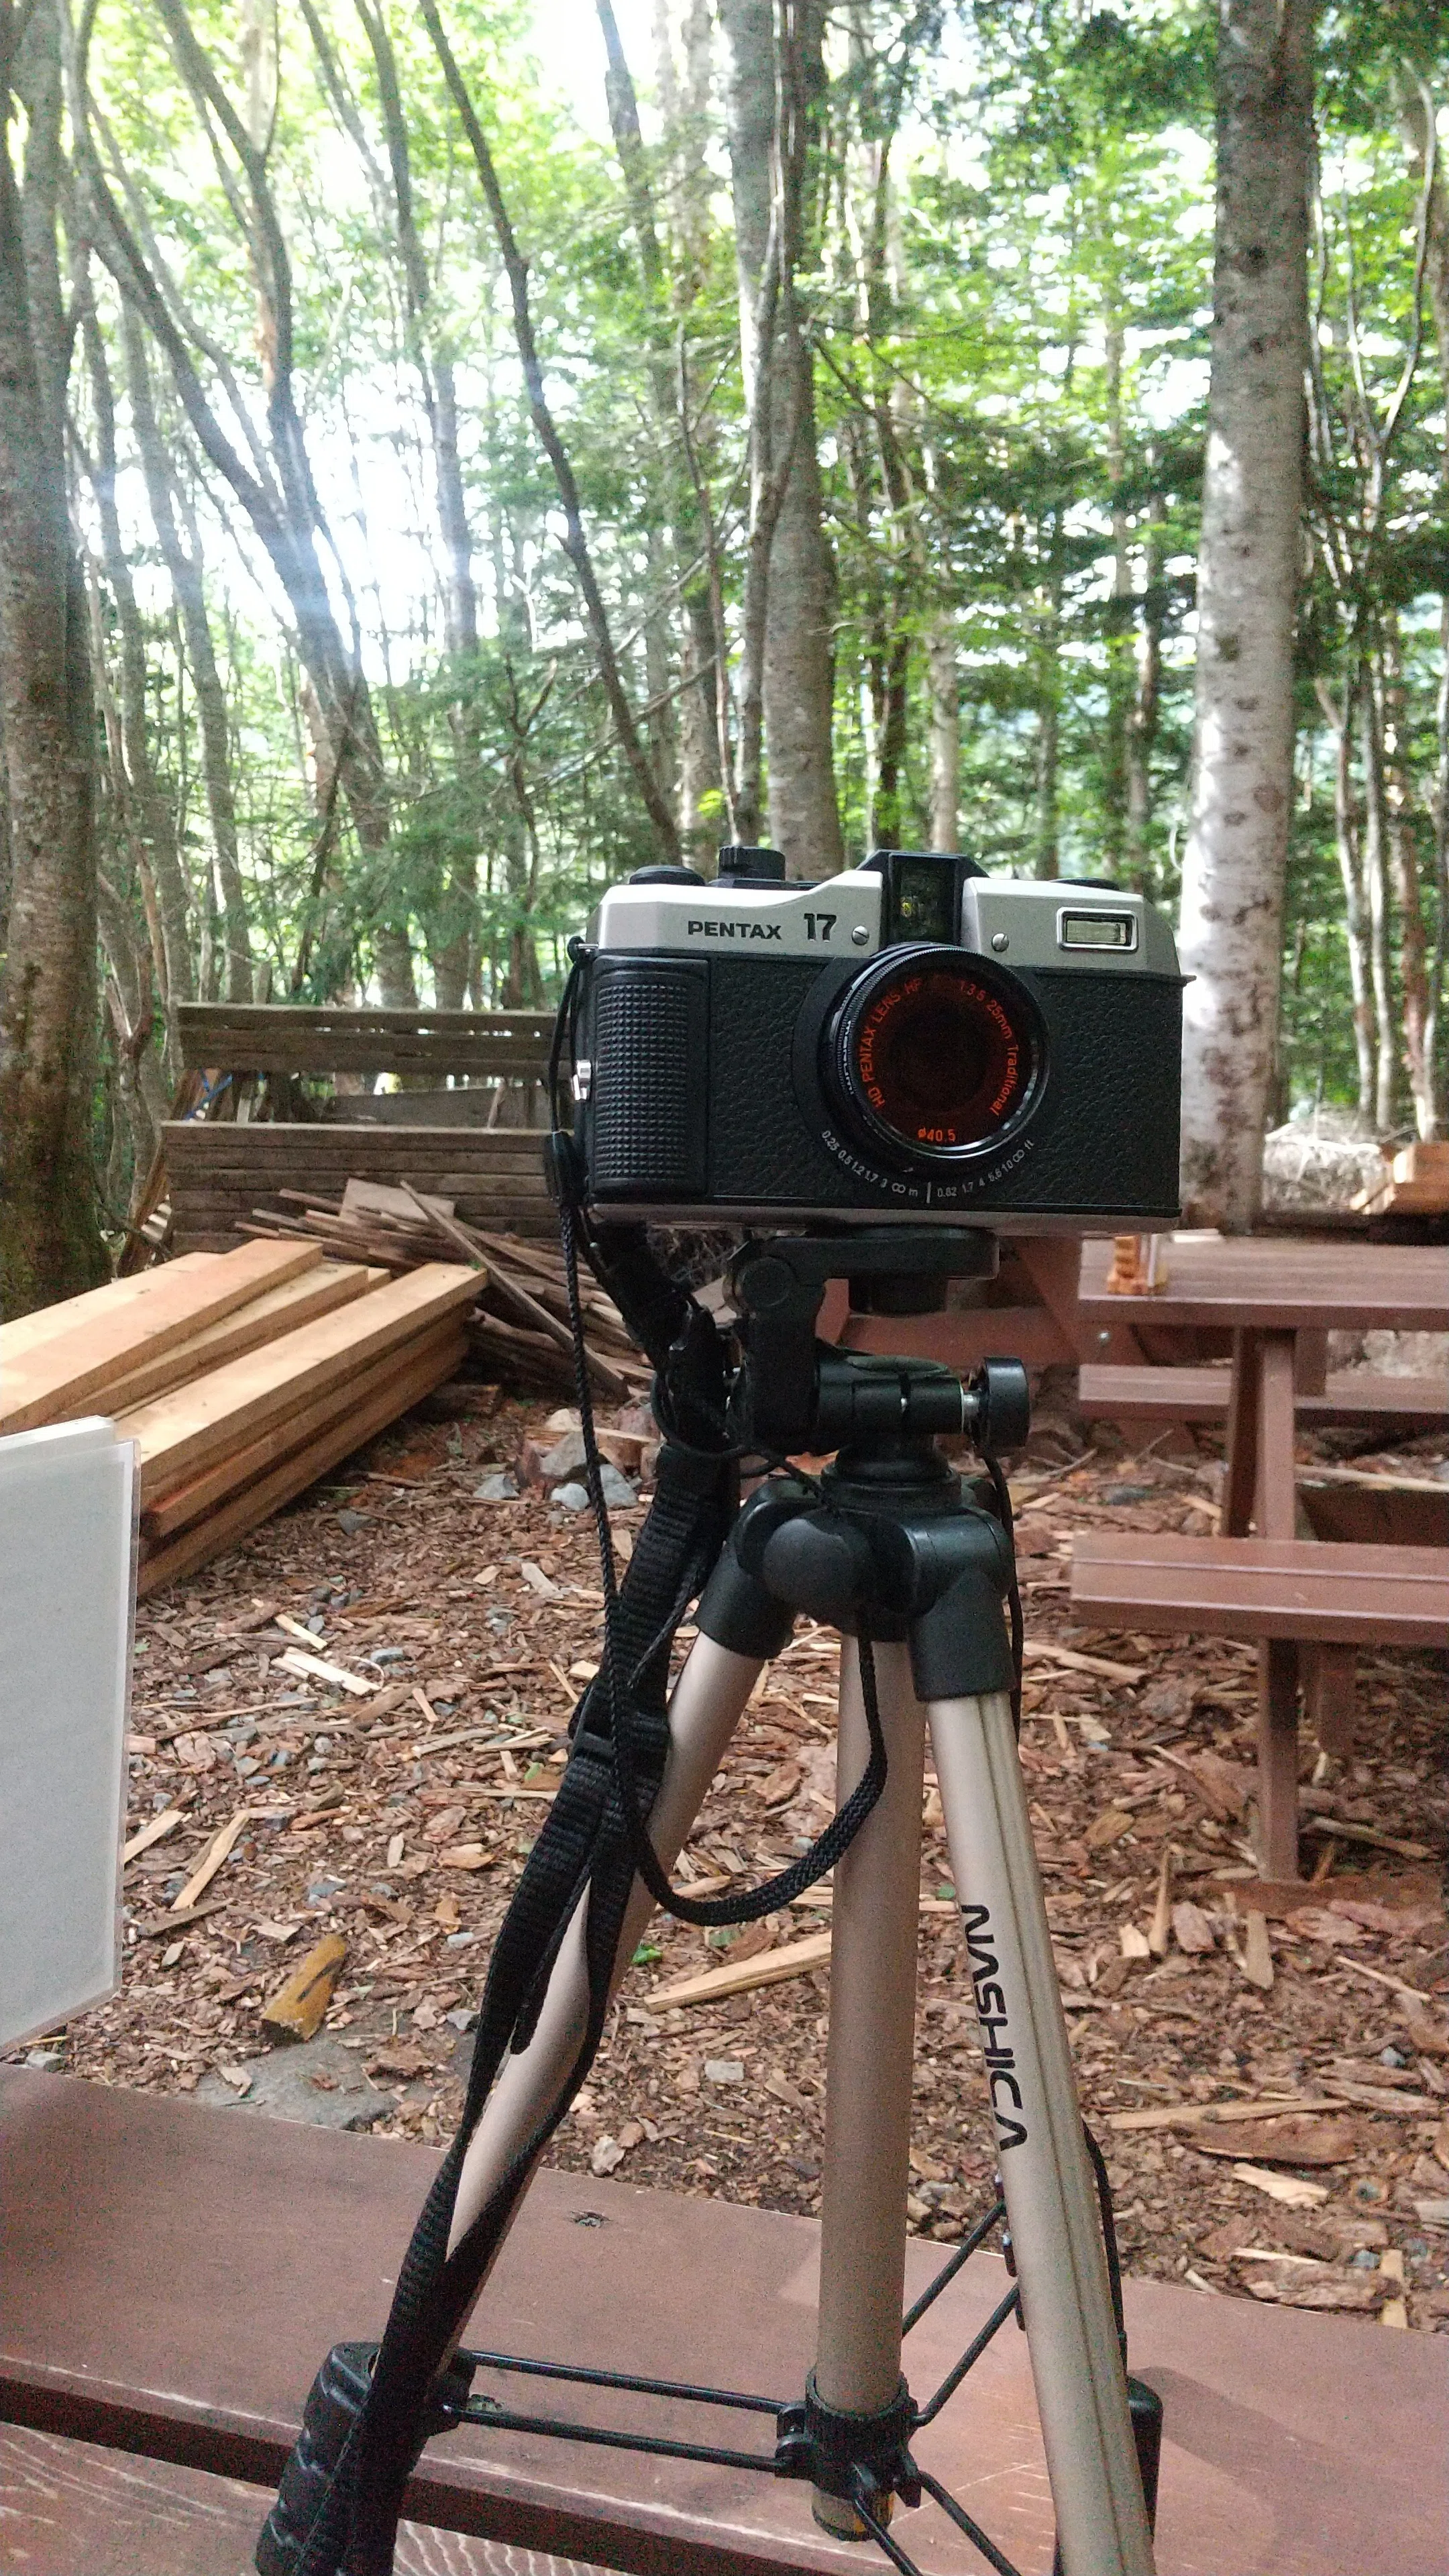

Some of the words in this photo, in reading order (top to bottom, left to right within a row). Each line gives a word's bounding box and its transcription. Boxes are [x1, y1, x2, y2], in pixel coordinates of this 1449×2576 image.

[688, 920, 782, 940] PENTAX
[803, 912, 837, 941] 17
[872, 993, 902, 1024] LENS
[985, 999, 1013, 1040] 25mm
[859, 1027, 877, 1083] PENTAX
[867, 1086, 886, 1109] HD
[989, 1044, 1020, 1117] Traditional
[822, 1130, 840, 1151] 0.25
[838, 1150, 853, 1165] 0.5
[961, 1904, 1028, 2152] NASHICA
